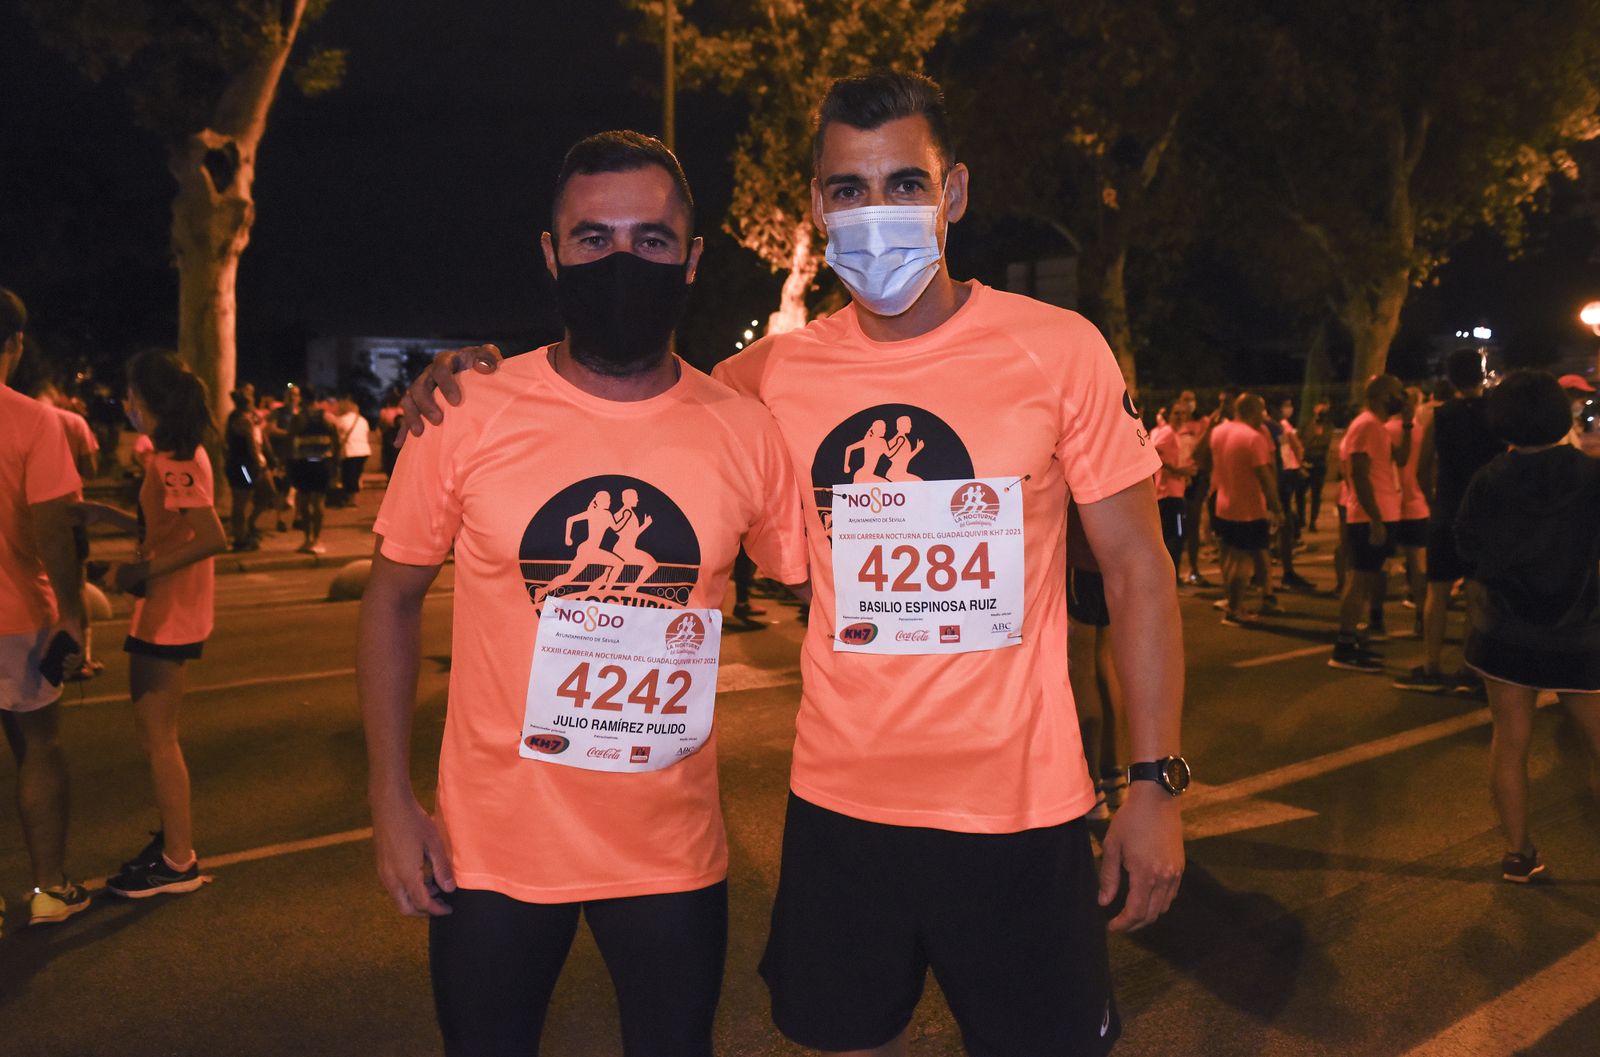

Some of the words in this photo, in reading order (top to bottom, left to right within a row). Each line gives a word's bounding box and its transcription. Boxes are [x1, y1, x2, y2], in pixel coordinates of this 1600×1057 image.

[963, 513, 996, 521] NOCTURNA
[885, 532, 921, 540] NOCTURNA
[936, 530, 988, 539] GUADALQUIVIR
[858, 541, 996, 592] 4284
[859, 600, 902, 613] BASILIO
[905, 600, 967, 613] ESPINOSA
[969, 598, 997, 611] RUIZ
[991, 622, 1012, 632] ABC
[562, 649, 594, 658] CARRERA
[594, 652, 633, 661] NOCTURNA
[633, 655, 646, 663] DEL
[646, 657, 692, 665] GUADALQUIVIR
[556, 661, 692, 715] 4242
[553, 714, 589, 730] JULIO
[590, 718, 645, 735] RAMÍREZ
[645, 722, 687, 735] PULIDO
